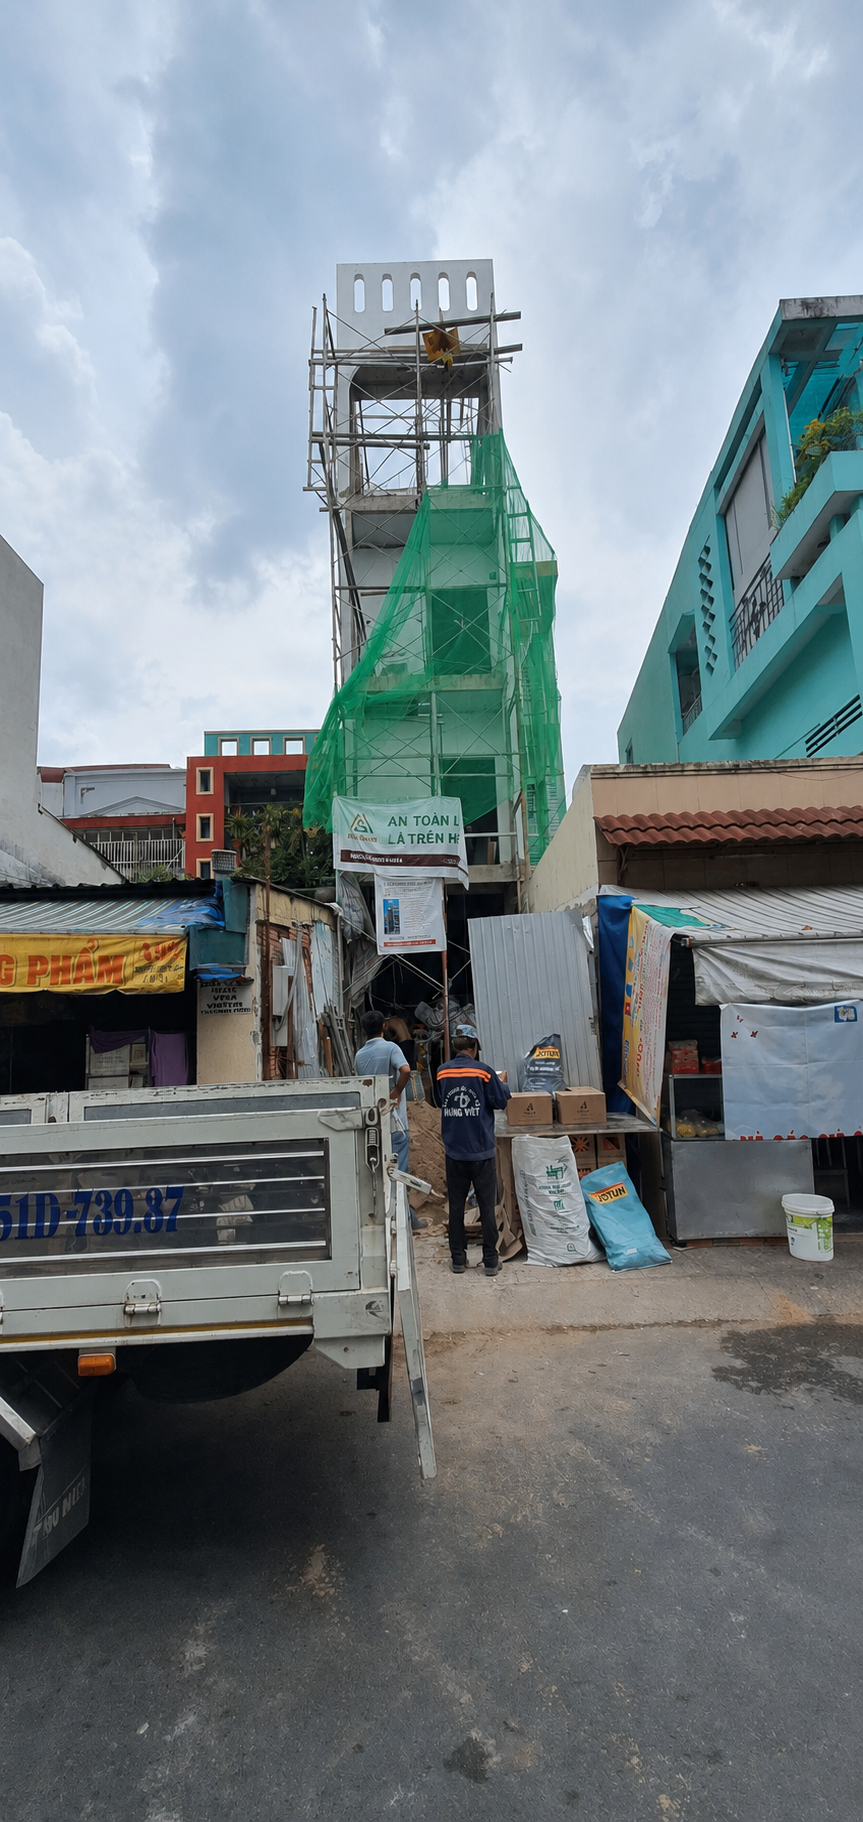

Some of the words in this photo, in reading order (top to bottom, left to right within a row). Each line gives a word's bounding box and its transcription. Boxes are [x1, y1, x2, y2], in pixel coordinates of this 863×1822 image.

[387, 816, 408, 827] AN
[413, 811, 449, 827] TOÀN
[27, 938, 125, 986] PHẨM
[0, 1185, 185, 1241] 51D-739.87
